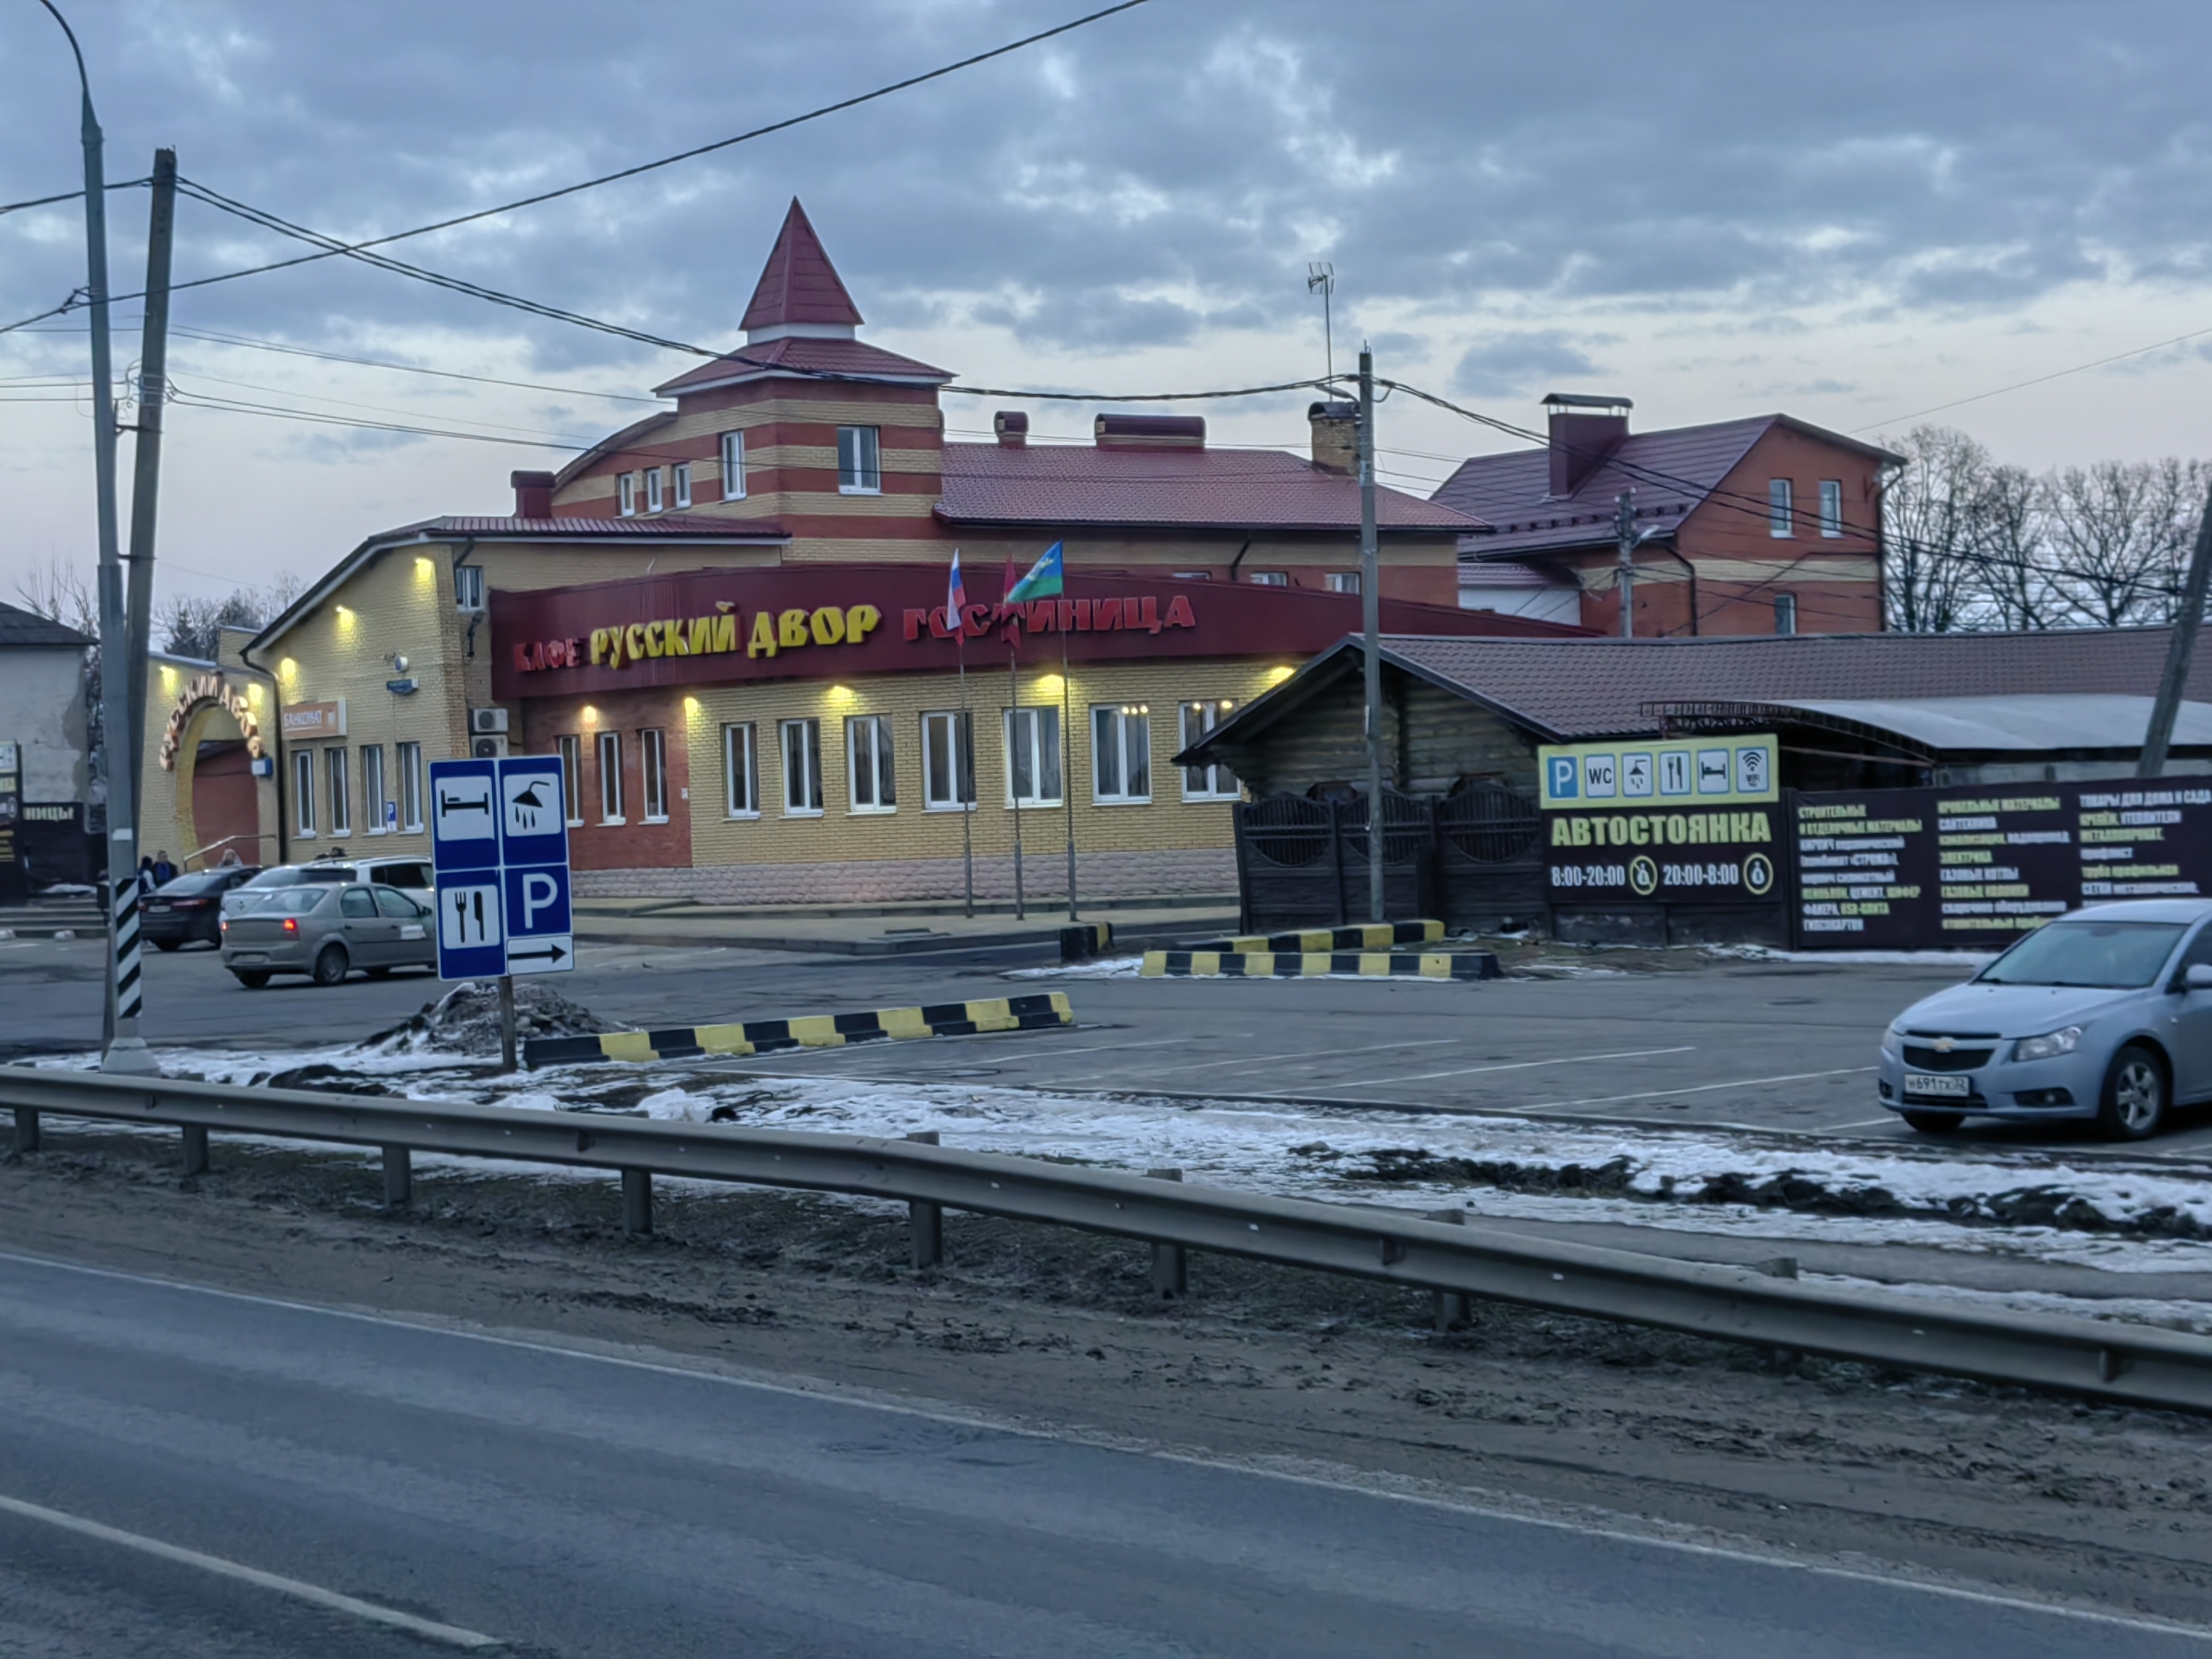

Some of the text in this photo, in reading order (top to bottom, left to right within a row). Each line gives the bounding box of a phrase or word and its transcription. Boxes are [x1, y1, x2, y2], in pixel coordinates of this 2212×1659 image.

[590, 601, 740, 670] РУССКИЙ
[747, 604, 881, 659] ДВОР
[1555, 760, 1573, 794] P
[1589, 767, 1612, 785] WC
[1552, 812, 1771, 846] АВТОСТОЯНКА
[1551, 865, 1626, 887] 8:00-20:00
[1663, 863, 1739, 886] 20:00-8:00
[522, 873, 558, 929] P
